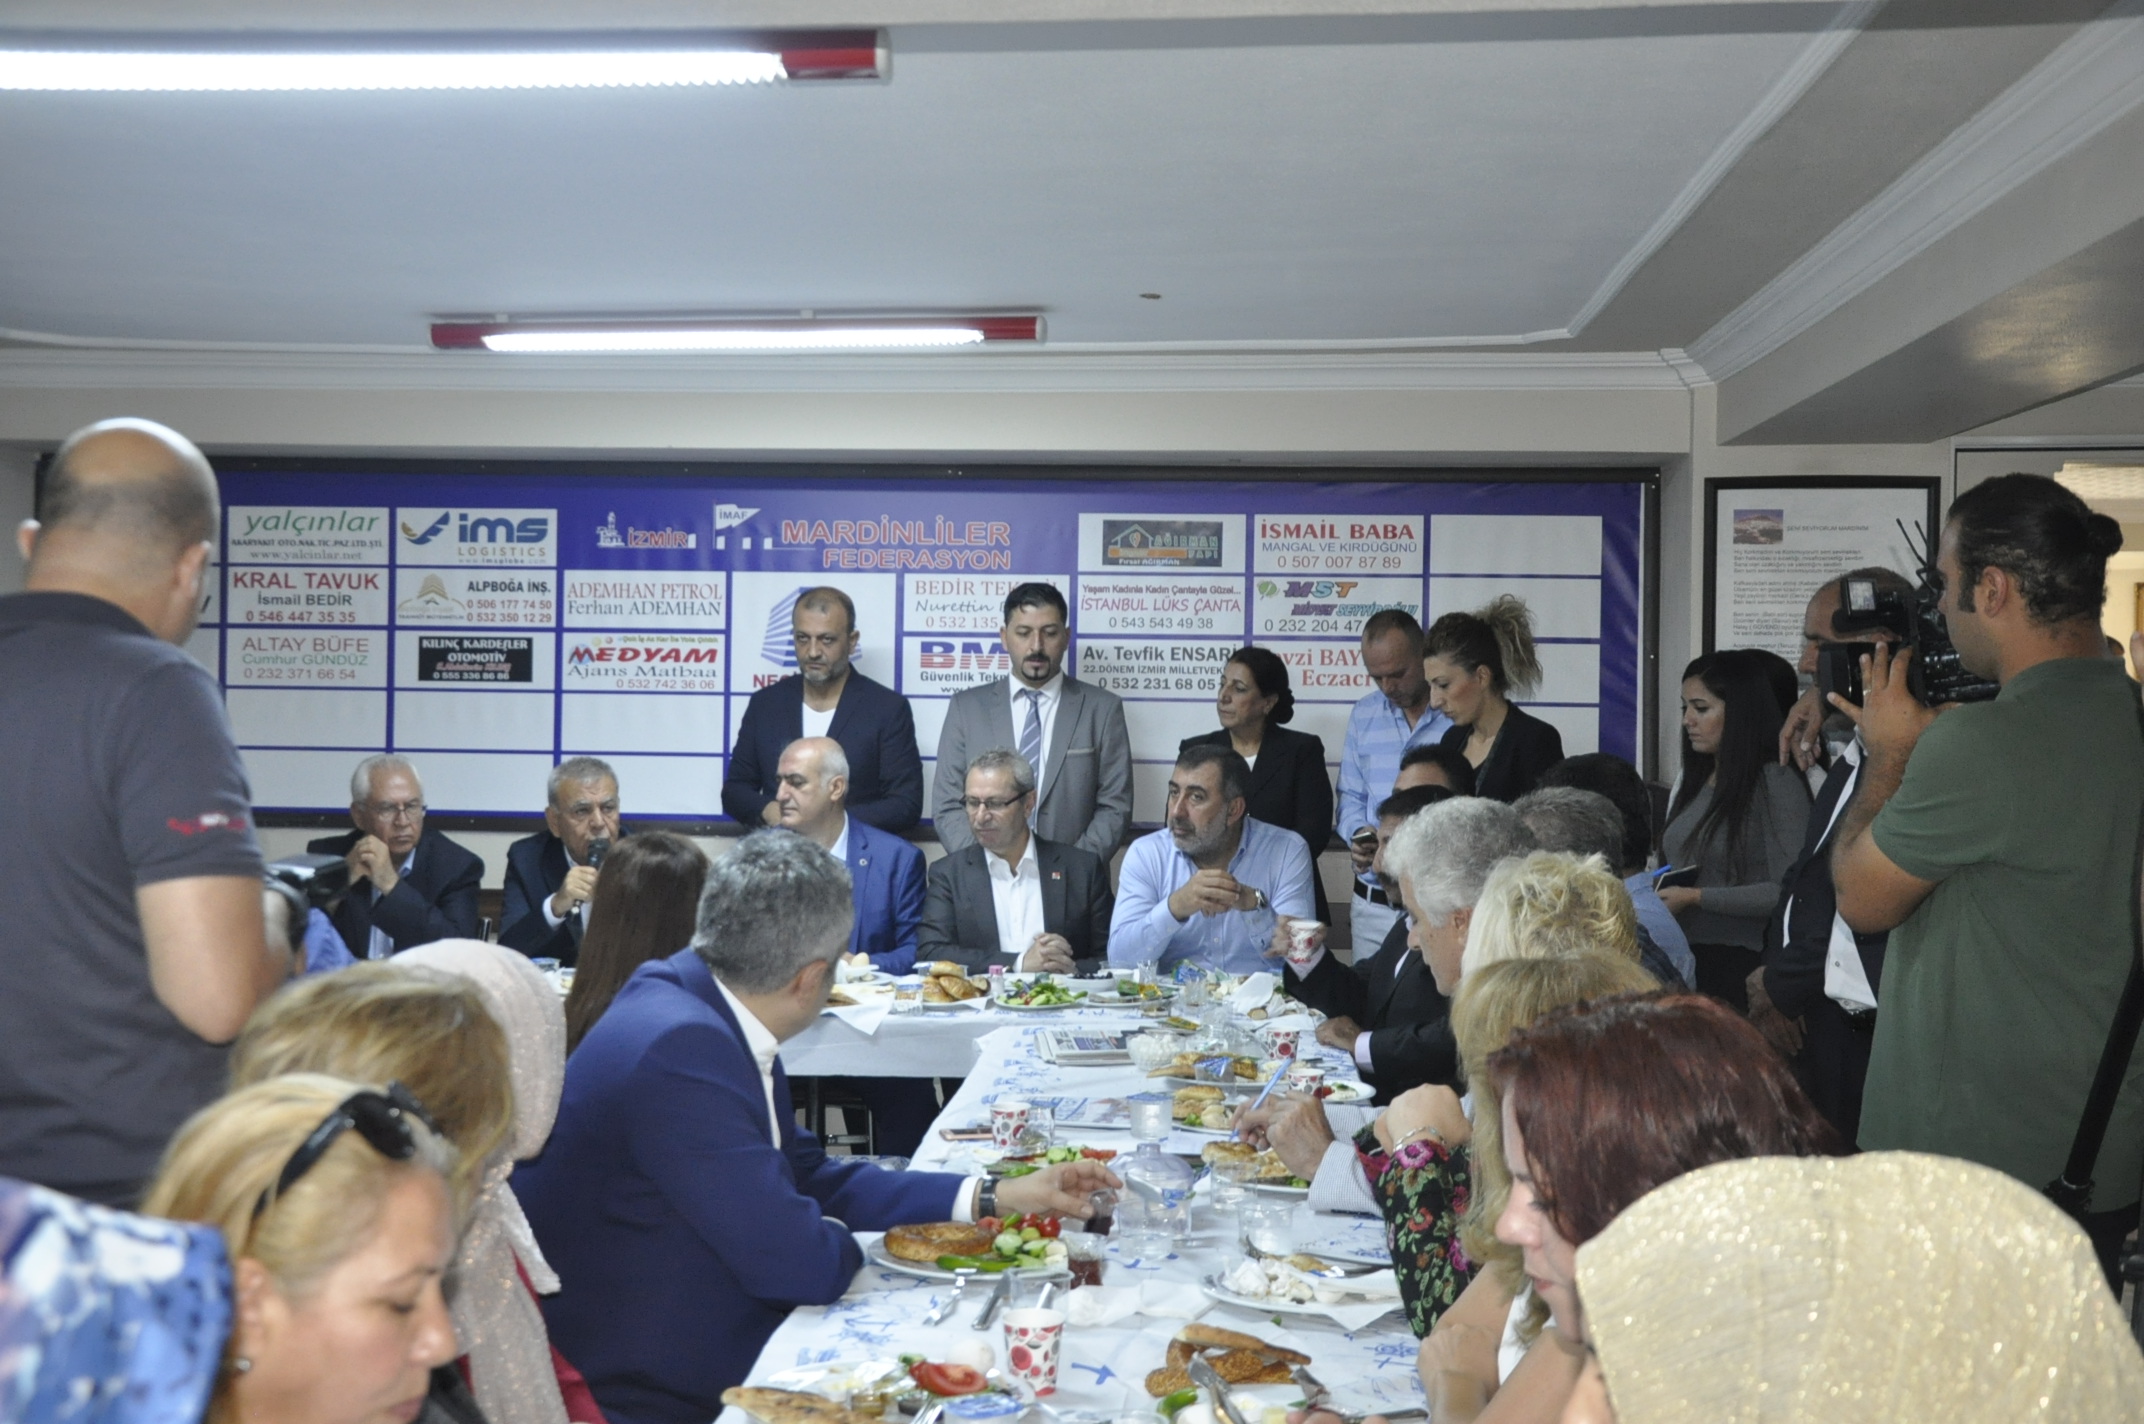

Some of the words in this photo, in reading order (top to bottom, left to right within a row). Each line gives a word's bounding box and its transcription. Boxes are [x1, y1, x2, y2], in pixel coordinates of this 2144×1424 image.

[244, 510, 379, 536] yalçınlar
[782, 514, 1011, 546] MARDİNLİLER
[1261, 519, 1340, 539] İSMAİL
[1350, 524, 1414, 539] BABA
[628, 527, 688, 548] İZMİR
[458, 547, 546, 557] LOGISTICS
[1262, 542, 1314, 552] MANGAL
[1319, 543, 1336, 552] VE
[823, 548, 1011, 570] FEDERASYON
[1277, 556, 1287, 568] 0
[1292, 556, 1319, 568] 507
[1325, 556, 1353, 568] 007
[1358, 557, 1376, 569] 87
[1382, 557, 1401, 569] 89
[233, 572, 297, 589] KRAL
[304, 573, 380, 590] TAVUK
[467, 577, 524, 593] ALPBOĞA
[916, 579, 975, 595] BEDİR
[257, 591, 301, 606] İsmail
[305, 592, 352, 606] BEDİR
[567, 583, 655, 599] ADEMHAN
[661, 583, 723, 600] PETROL
[467, 600, 474, 609] 0
[476, 600, 496, 609] 506
[501, 600, 519, 609] 177
[523, 600, 536, 610] 74
[539, 600, 552, 610] 50
[568, 600, 624, 614] Ferhan
[628, 601, 721, 616] ADEMHAN
[915, 599, 994, 613] Nurettin
[1080, 595, 1148, 611] İSTANBUL
[1153, 596, 1189, 612] LÜKS
[1194, 598, 1241, 616] ÇANTA
[246, 611, 254, 621] 0
[259, 611, 284, 622] 546
[288, 611, 313, 622] 447
[318, 612, 335, 623] 35
[338, 612, 356, 623] 35
[467, 613, 474, 622] 0
[476, 613, 496, 622] 532
[500, 613, 519, 622] 350
[523, 613, 536, 623] 12
[538, 613, 552, 623] 29
[926, 617, 934, 628] 0
[939, 616, 966, 628] 532
[973, 616, 998, 628] 135
[1109, 617, 1117, 628] 0
[1121, 617, 1145, 628] 543
[1150, 617, 1173, 628] 543
[1177, 617, 1193, 629] 49
[1197, 617, 1214, 629] 38
[1264, 619, 1274, 631] 0
[1278, 619, 1306, 632] 232
[1311, 619, 1338, 632] 204
[1344, 619, 1362, 632] 47
[242, 637, 306, 652] ALTAY
[312, 635, 369, 653] BÜFE
[242, 654, 298, 665] Cumhur
[302, 653, 368, 666] GÜNDÜZ
[568, 646, 718, 664] MEDYAM
[1083, 646, 1108, 661] Av.
[1114, 646, 1165, 661] Tevfik
[244, 668, 252, 678] 0
[257, 668, 283, 679] 232
[288, 669, 312, 679] 371
[317, 669, 335, 680] 66
[339, 669, 356, 680] 54
[433, 672, 441, 680] 0
[567, 665, 628, 679] Ajans
[635, 665, 717, 678] Matbaa
[920, 671, 975, 682] Güvenlik
[1137, 664, 1166, 674] İZMİR
[1169, 664, 1224, 675] MİLLETVEK
[617, 679, 624, 689] 0
[628, 679, 650, 689] 532
[655, 680, 676, 689] 742
[681, 680, 695, 689] 36
[700, 680, 715, 689] 06
[1098, 677, 1107, 689] 0
[1112, 677, 1139, 689] 532
[1143, 678, 1171, 690] 231
[1175, 678, 1193, 690] 68
[1197, 678, 1216, 691] 05
